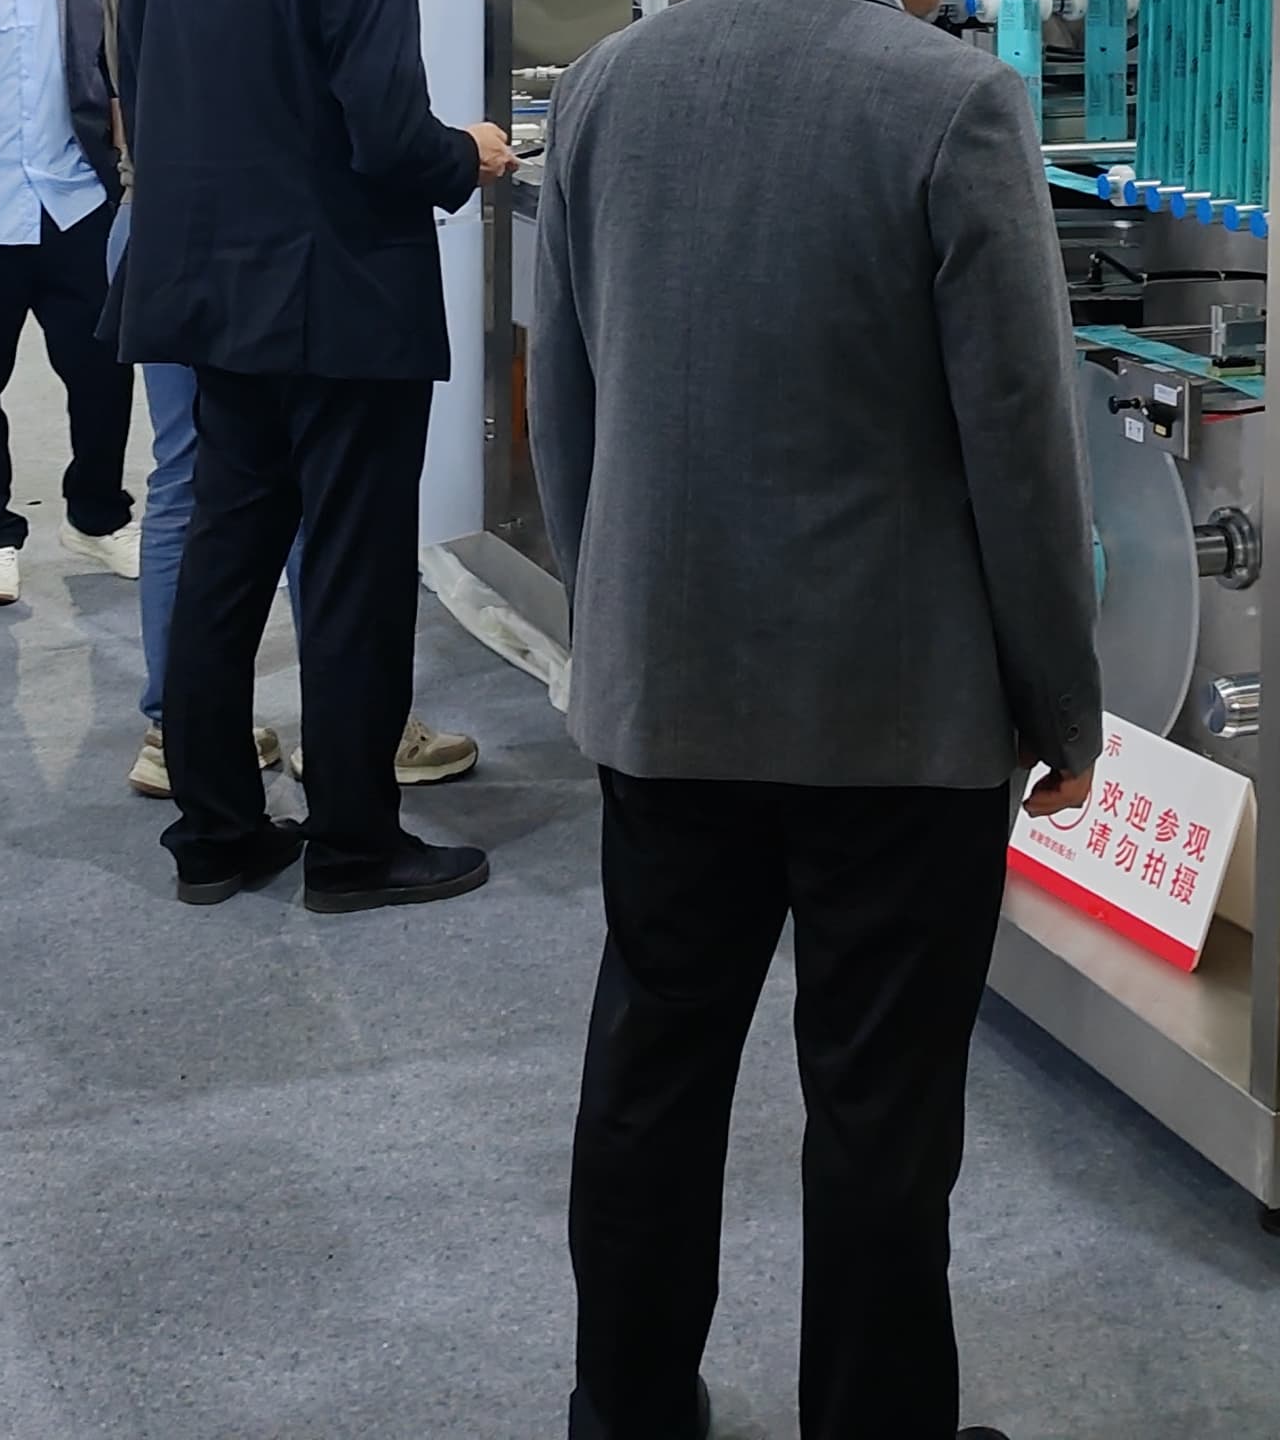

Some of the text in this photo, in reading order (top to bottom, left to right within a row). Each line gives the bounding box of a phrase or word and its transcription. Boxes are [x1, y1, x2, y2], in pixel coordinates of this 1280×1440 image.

[1086, 818, 1199, 905] 请勿拍摄
[1098, 780, 1211, 863] 欢迎参观
